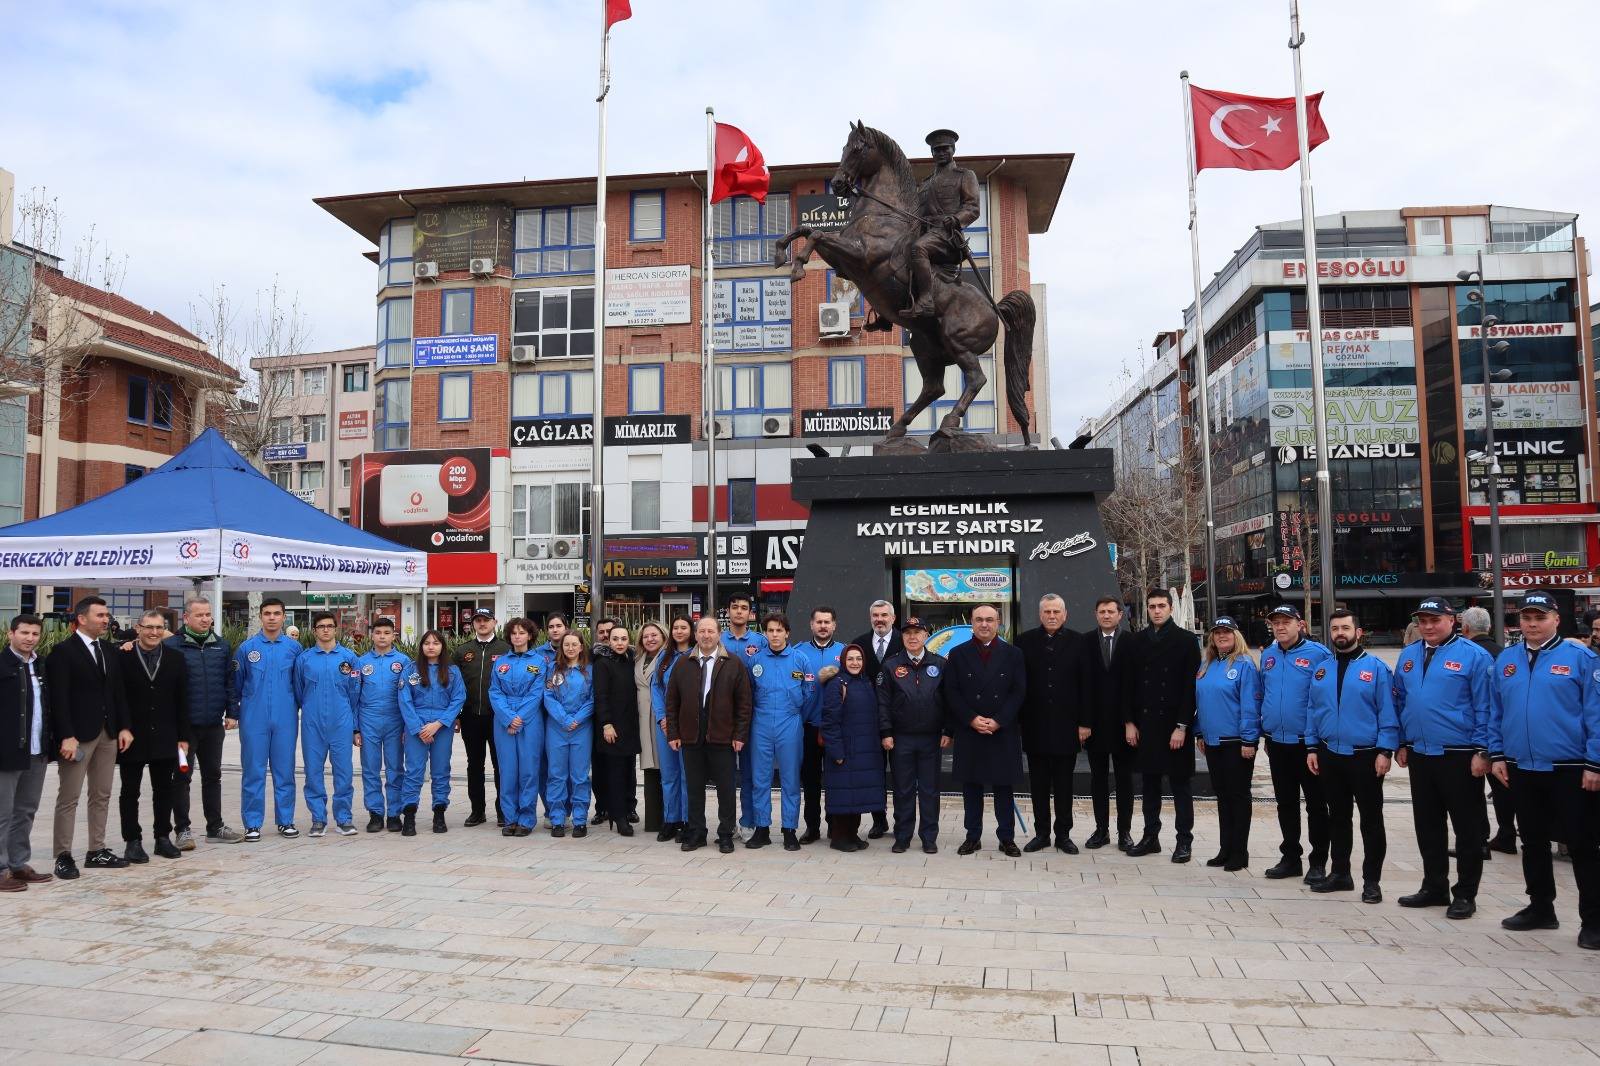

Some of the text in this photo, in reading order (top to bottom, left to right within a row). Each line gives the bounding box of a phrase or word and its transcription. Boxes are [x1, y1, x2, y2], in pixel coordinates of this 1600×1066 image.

[1344, 330, 1380, 340] CAFE
[431, 344, 495, 354] TÜRKAN ŞANS
[1326, 344, 1370, 354] RE/MAX
[1508, 383, 1571, 394] KAMYON
[1296, 400, 1418, 424] YAVUZ
[804, 412, 892, 432] MÜHENDİSLİK
[514, 420, 677, 446] ÇAĞLAR MİMARLIK
[1354, 427, 1417, 444] KURSU
[449, 466, 467, 474] 200
[856, 518, 1044, 537] KAYITSIZ ŞARTSIZ
[446, 534, 484, 542] vodafone
[74, 545, 154, 567] BELEDİYESİ
[766, 535, 804, 570] AS
[272, 552, 336, 572] ÇERKEZKÖY
[338, 558, 391, 576] BELEDİYESİ
[536, 571, 570, 581] MERKEZİ
[629, 565, 670, 578] İLETİŞİM
[1341, 574, 1398, 584] PANCAKES
[1503, 572, 1594, 586] KÖFTECİ
